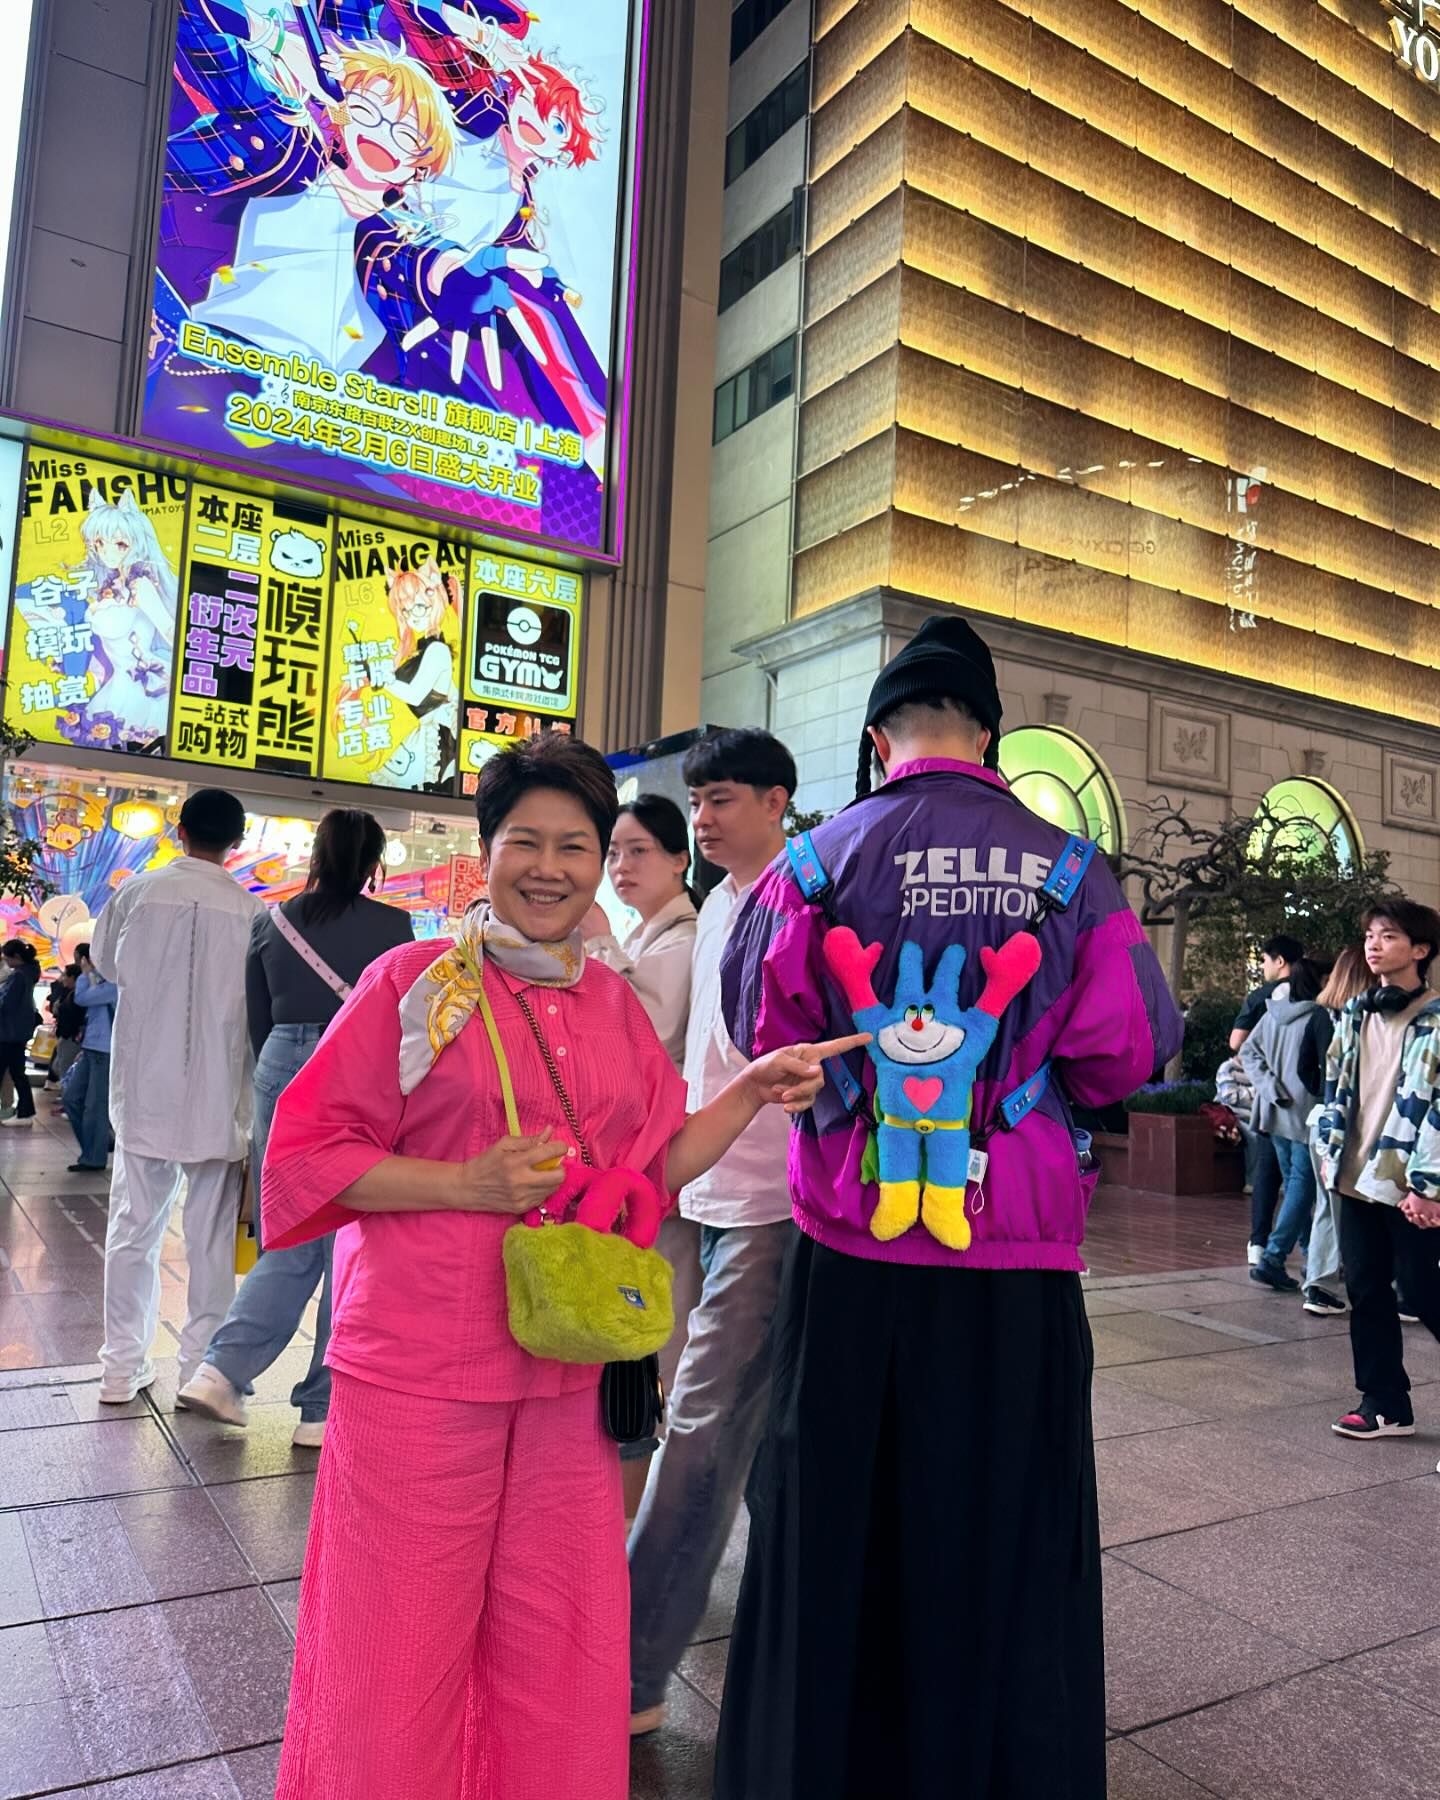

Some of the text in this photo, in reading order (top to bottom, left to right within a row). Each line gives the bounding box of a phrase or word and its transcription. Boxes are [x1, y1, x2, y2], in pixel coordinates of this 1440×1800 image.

[183, 322, 337, 391] Ensemble
[344, 373, 438, 419] Stars!!
[445, 401, 517, 444] 旗舰店
[536, 428, 582, 461] 上海
[230, 396, 538, 501] 2024年2月6日盛大开业
[27, 459, 87, 481] Miss
[34, 518, 69, 544] L2
[197, 494, 263, 533] 本座
[193, 524, 262, 566] 二层
[338, 529, 385, 548] Miss
[31, 569, 97, 607] 谷子
[344, 582, 374, 606] L6
[475, 558, 577, 604] 本座六层
[220, 570, 259, 672] 二次元
[25, 622, 95, 661] 模玩
[182, 592, 224, 697] 衍生品
[539, 653, 560, 665] TCG
[480, 654, 542, 687] GYM
[20, 675, 90, 714] 抽赏
[339, 694, 393, 729] 专业
[180, 703, 249, 728] 一站式
[178, 721, 247, 759] 购物
[894, 847, 1052, 890] ZELLE
